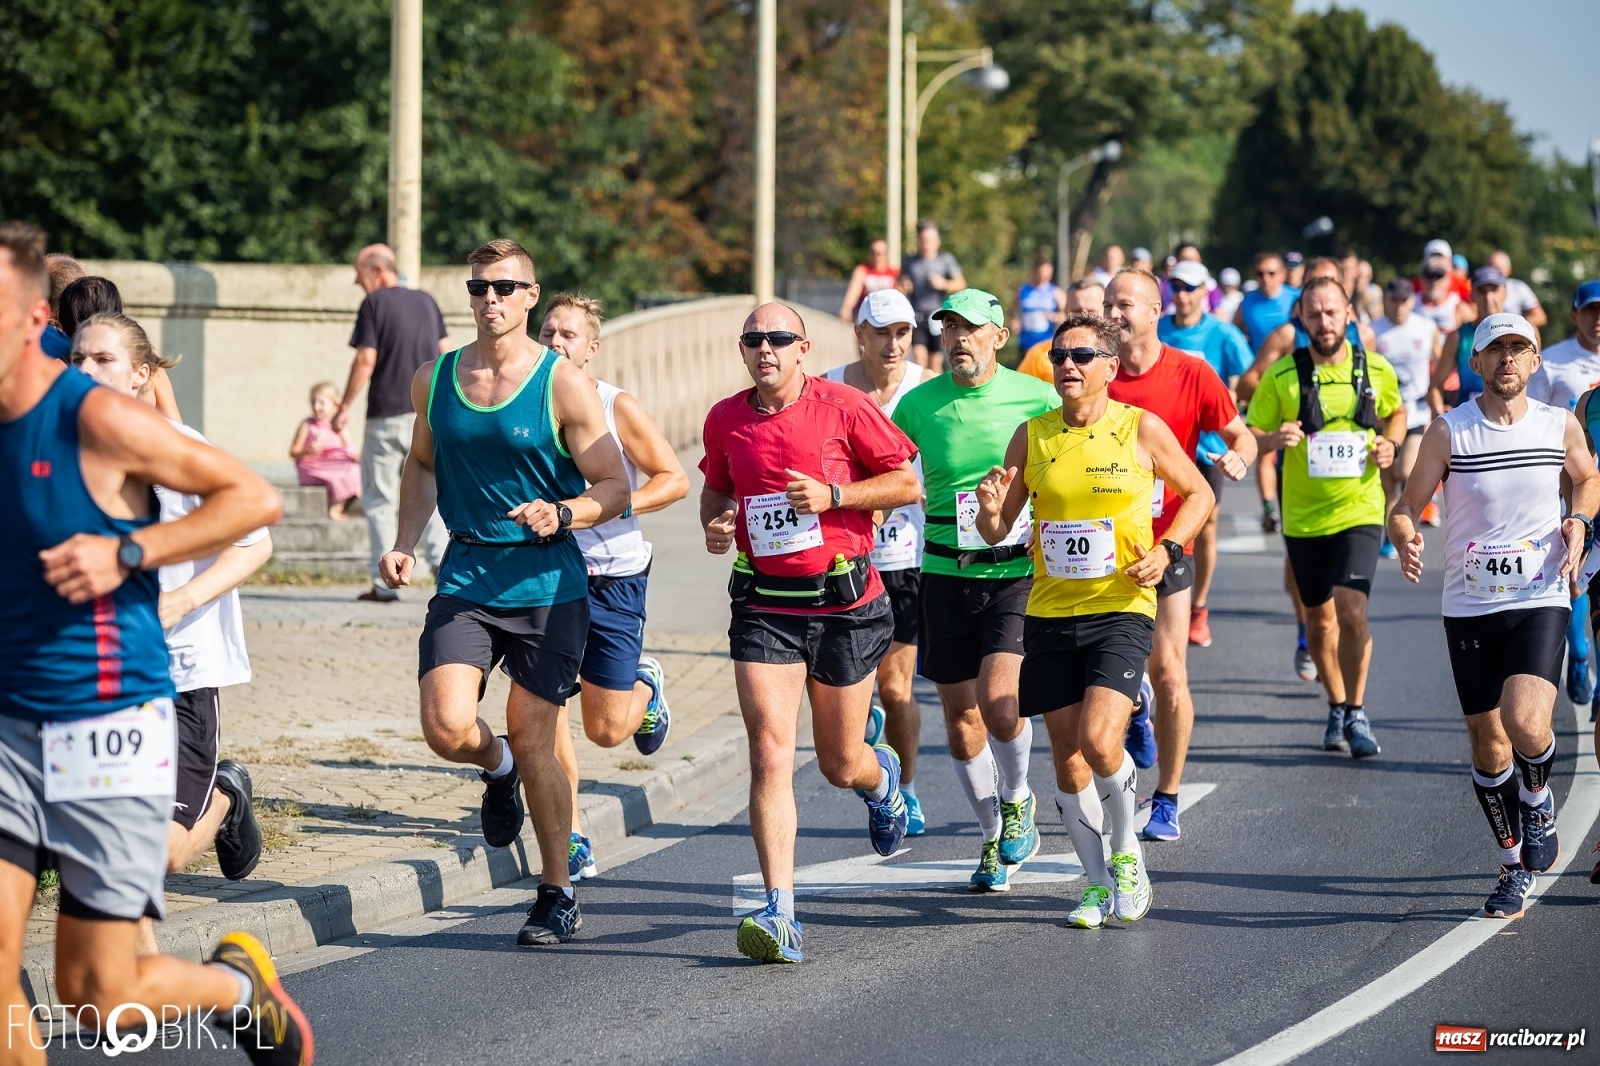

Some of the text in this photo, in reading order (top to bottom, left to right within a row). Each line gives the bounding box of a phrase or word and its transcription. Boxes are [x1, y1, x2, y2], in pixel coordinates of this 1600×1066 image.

[1329, 445, 1353, 458] 183
[763, 508, 799, 531] 254
[1065, 537, 1090, 555] 20
[1486, 556, 1523, 576] 461
[88, 729, 142, 757] 109
